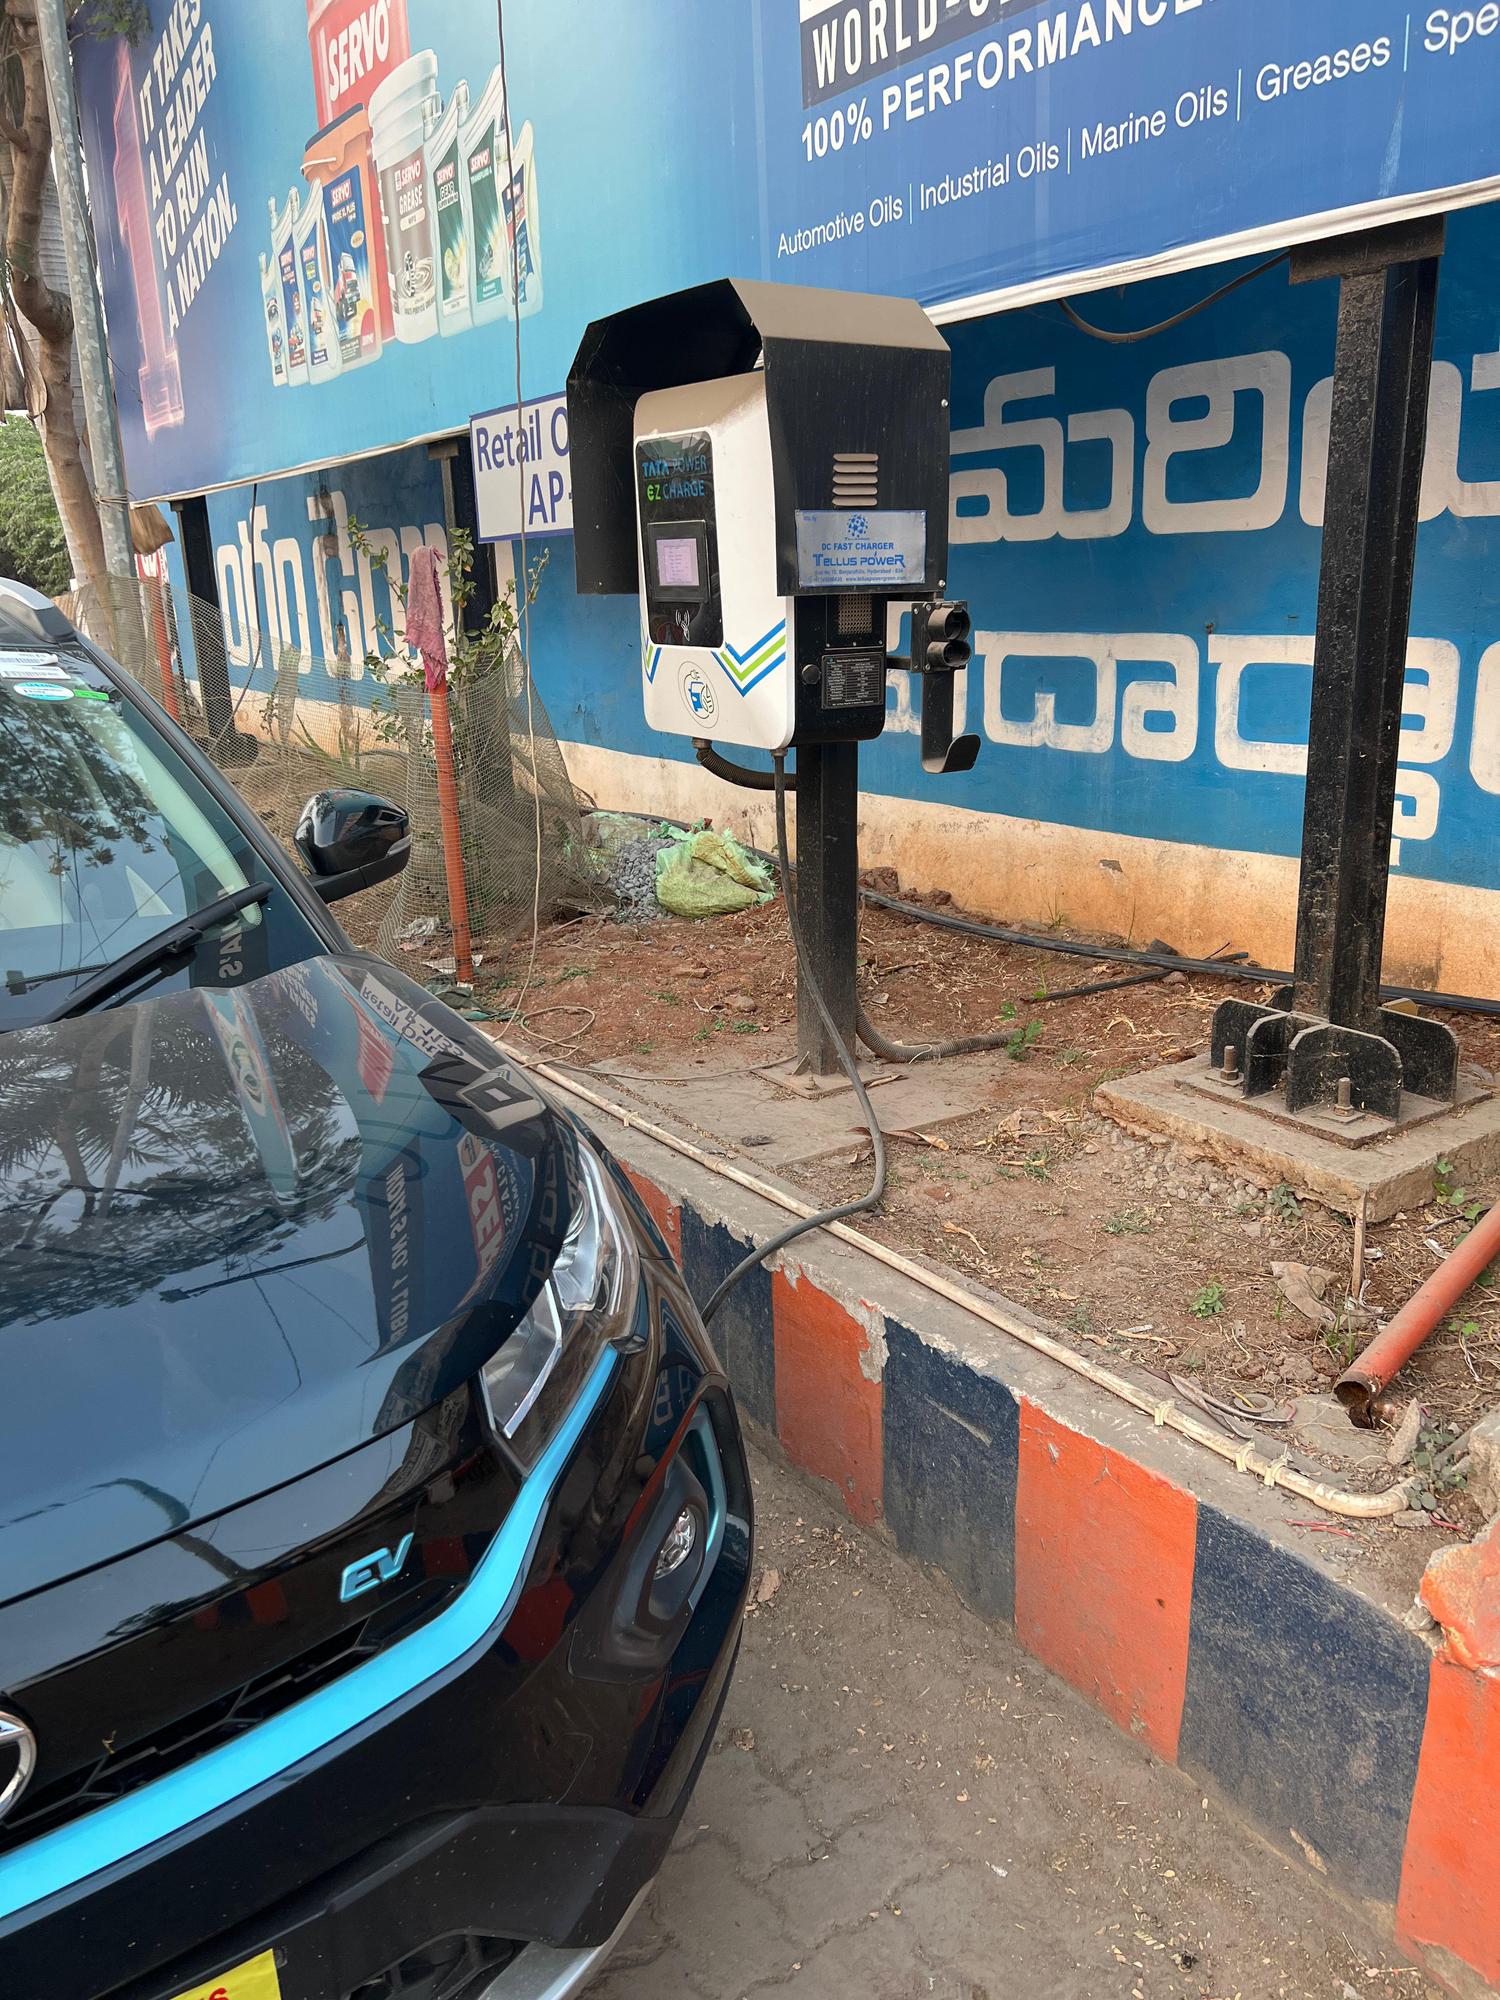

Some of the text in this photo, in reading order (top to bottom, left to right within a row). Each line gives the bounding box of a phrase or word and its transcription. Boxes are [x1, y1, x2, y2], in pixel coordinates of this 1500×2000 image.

[328, 0, 390, 102] SERVO
[812, 0, 1016, 89] WORLD-
[140, 69, 155, 145] IT
[802, 0, 1203, 162] 100% PERFORMANC
[151, 22, 217, 211] A LEADER
[777, 210, 865, 259] Automotive
[869, 194, 904, 228] Oils
[920, 153, 1010, 211] Industrial
[1017, 141, 1060, 179] Oils
[1081, 108, 1166, 160] Marine
[1174, 84, 1229, 128] Oils
[1256, 36, 1392, 102] Greases
[401, 160, 421, 188] SERVO
[437, 162, 454, 187] SERVO
[440, 181, 454, 201] GEAR
[471, 148, 490, 174] SERVO
[156, 126, 210, 271] TO RUN
[400, 184, 423, 216] GREASE
[166, 171, 238, 338] A NATION.
[476, 409, 542, 472] Retail
[642, 455, 707, 477] TATA POWER
[662, 479, 705, 499] CHARGE
[821, 543, 832, 551] DC
[855, 542, 894, 550] CHARGER
[340, 1532, 414, 1603] EV
